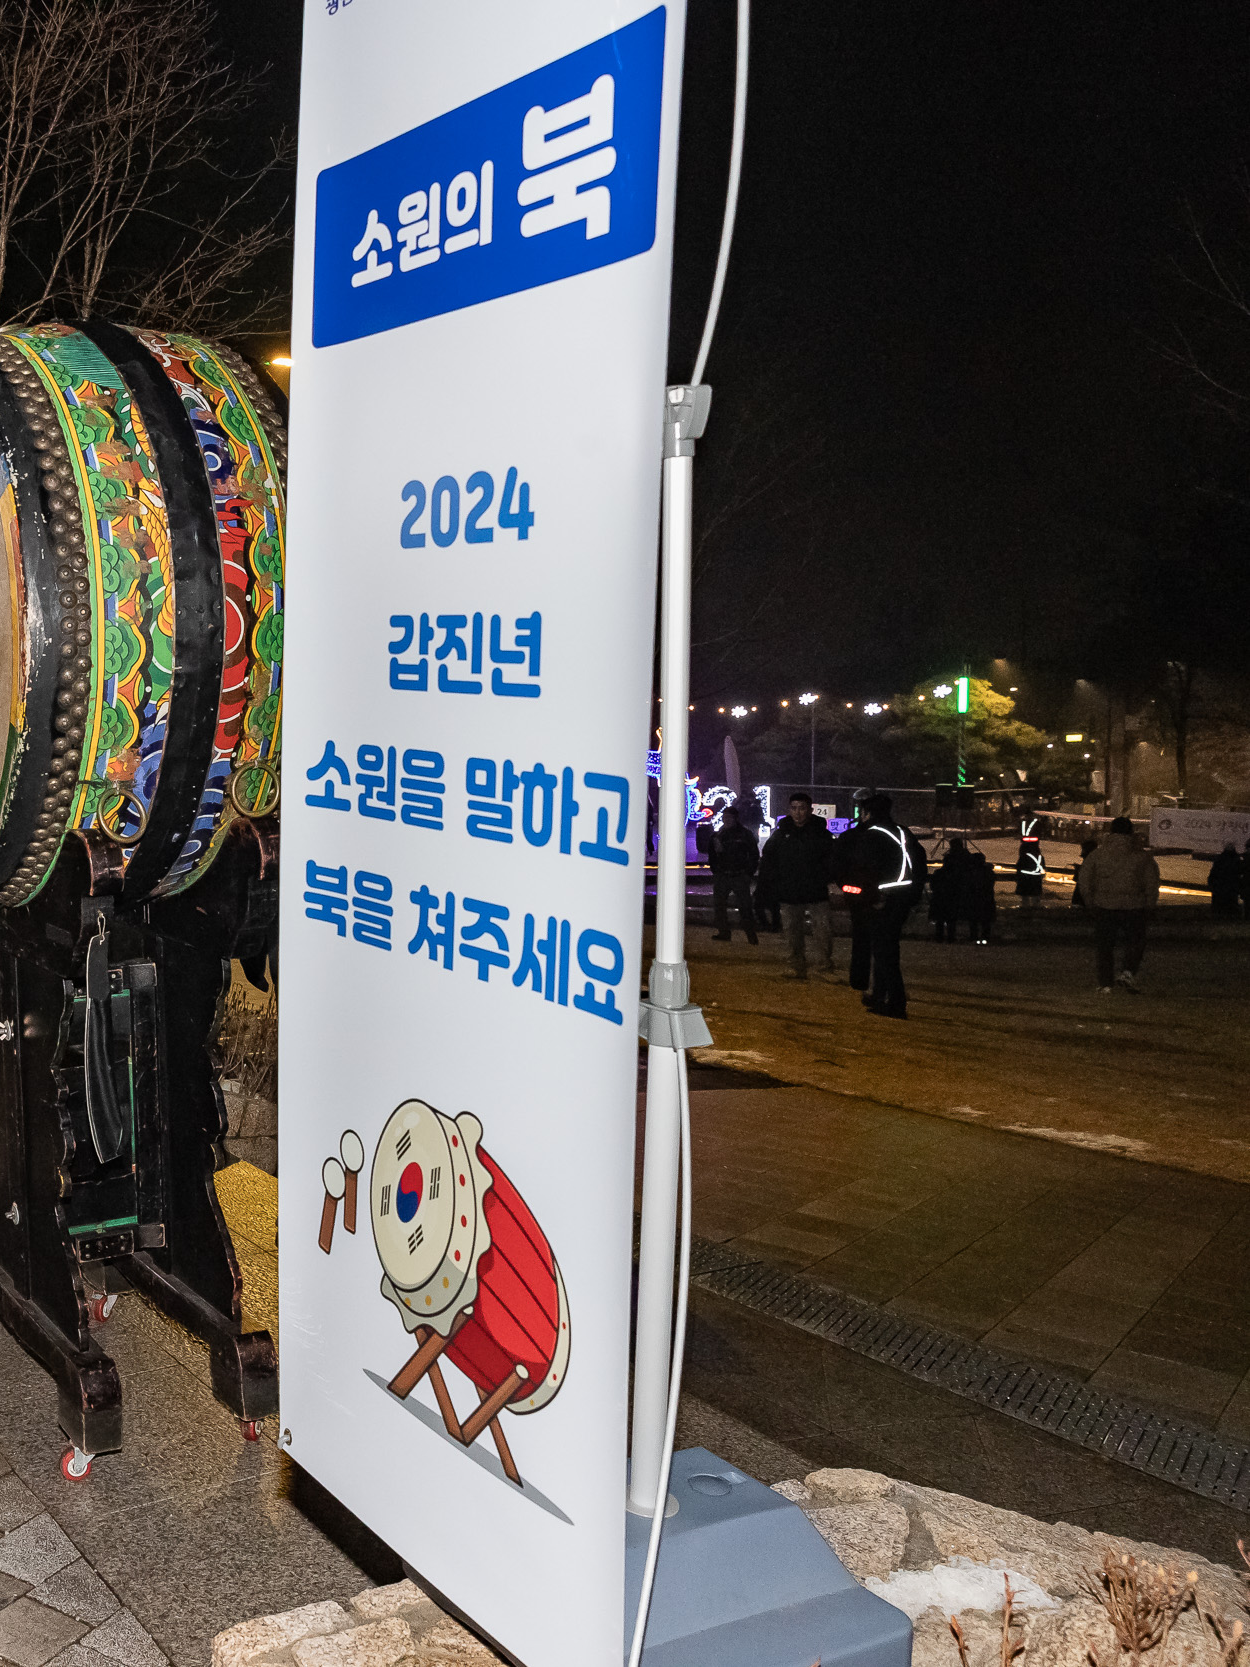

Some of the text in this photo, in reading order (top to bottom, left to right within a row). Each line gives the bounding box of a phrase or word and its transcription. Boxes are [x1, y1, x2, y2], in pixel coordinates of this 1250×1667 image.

[351, 74, 617, 288] 소원의 북
[400, 466, 535, 549] 2024
[387, 610, 543, 699] 갑진년
[304, 739, 631, 868] 소원을 말하고
[303, 859, 626, 1027] 북을 쳐주세요
